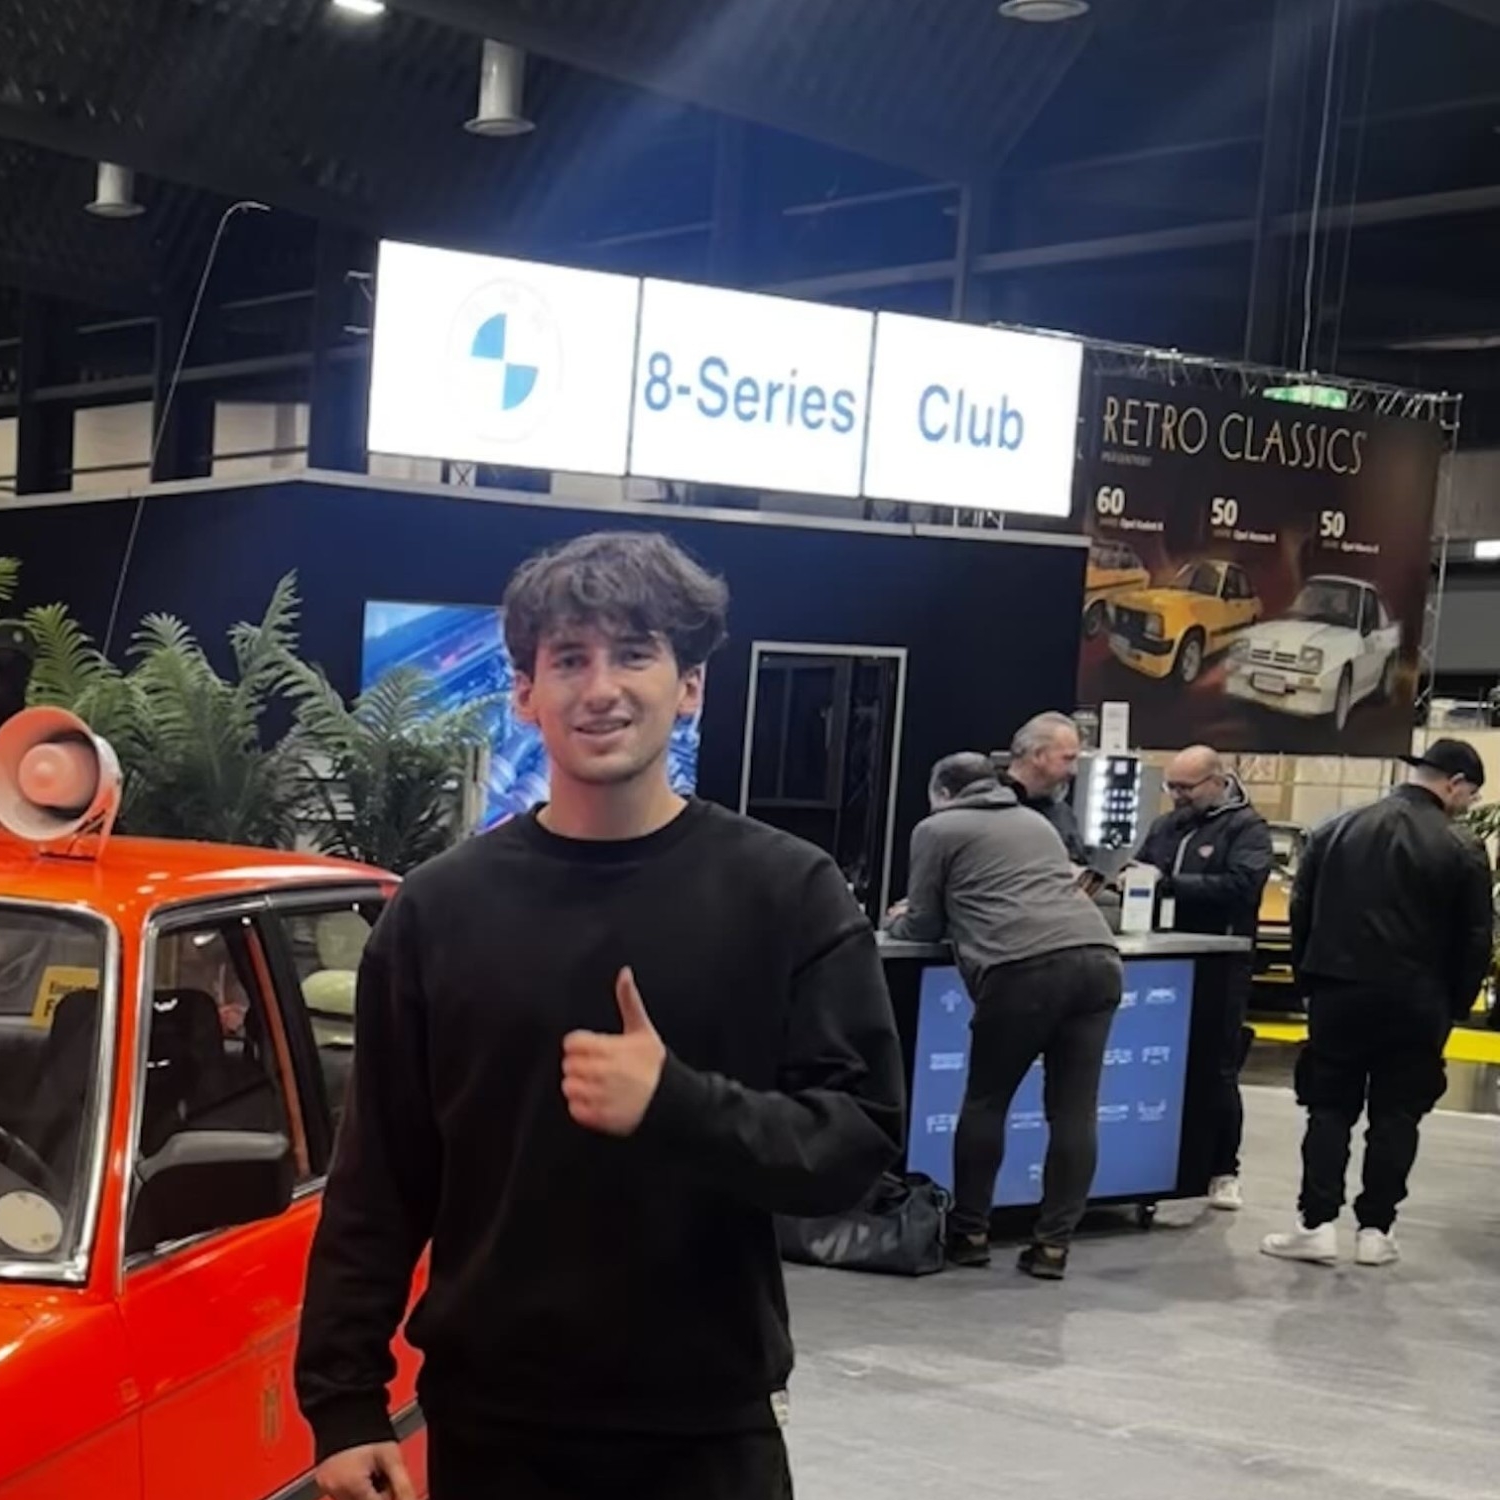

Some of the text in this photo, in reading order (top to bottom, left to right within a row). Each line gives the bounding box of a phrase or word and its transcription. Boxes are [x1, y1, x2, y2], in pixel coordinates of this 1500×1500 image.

[643, 351, 1025, 451] 8-Series Club
[1102, 396, 1368, 475] RETRO CLASSICS
[1096, 485, 1126, 516] 60
[1210, 497, 1239, 527] 50
[1319, 510, 1346, 539] 50
